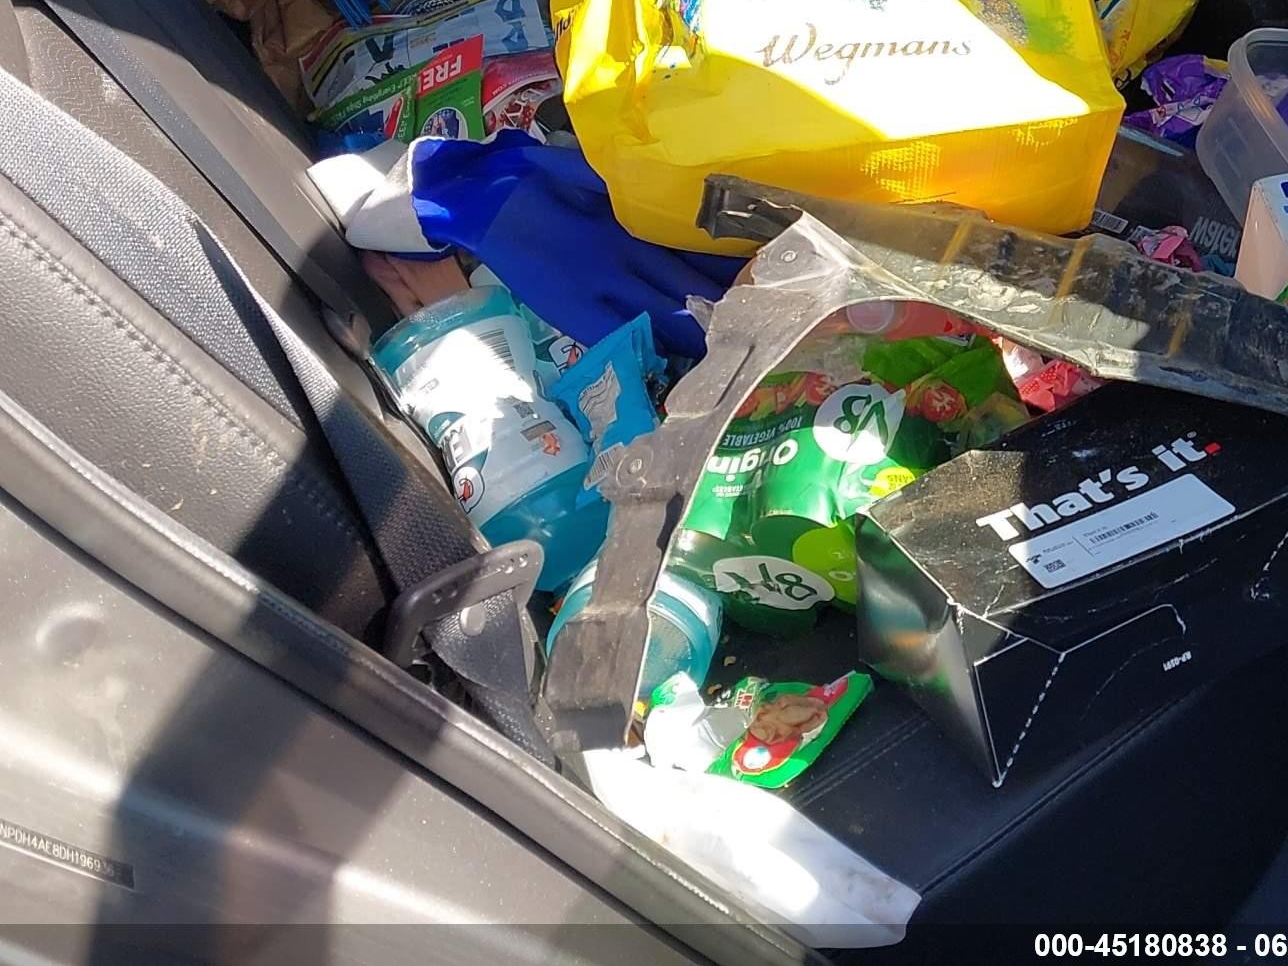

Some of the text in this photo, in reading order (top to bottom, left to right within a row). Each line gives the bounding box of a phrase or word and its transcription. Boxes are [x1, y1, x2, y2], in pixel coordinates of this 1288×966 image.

[754, 21, 971, 85] Wegmans
[723, 427, 776, 447] VEGETABLE
[833, 394, 889, 452] V8
[976, 466, 1149, 541] That's
